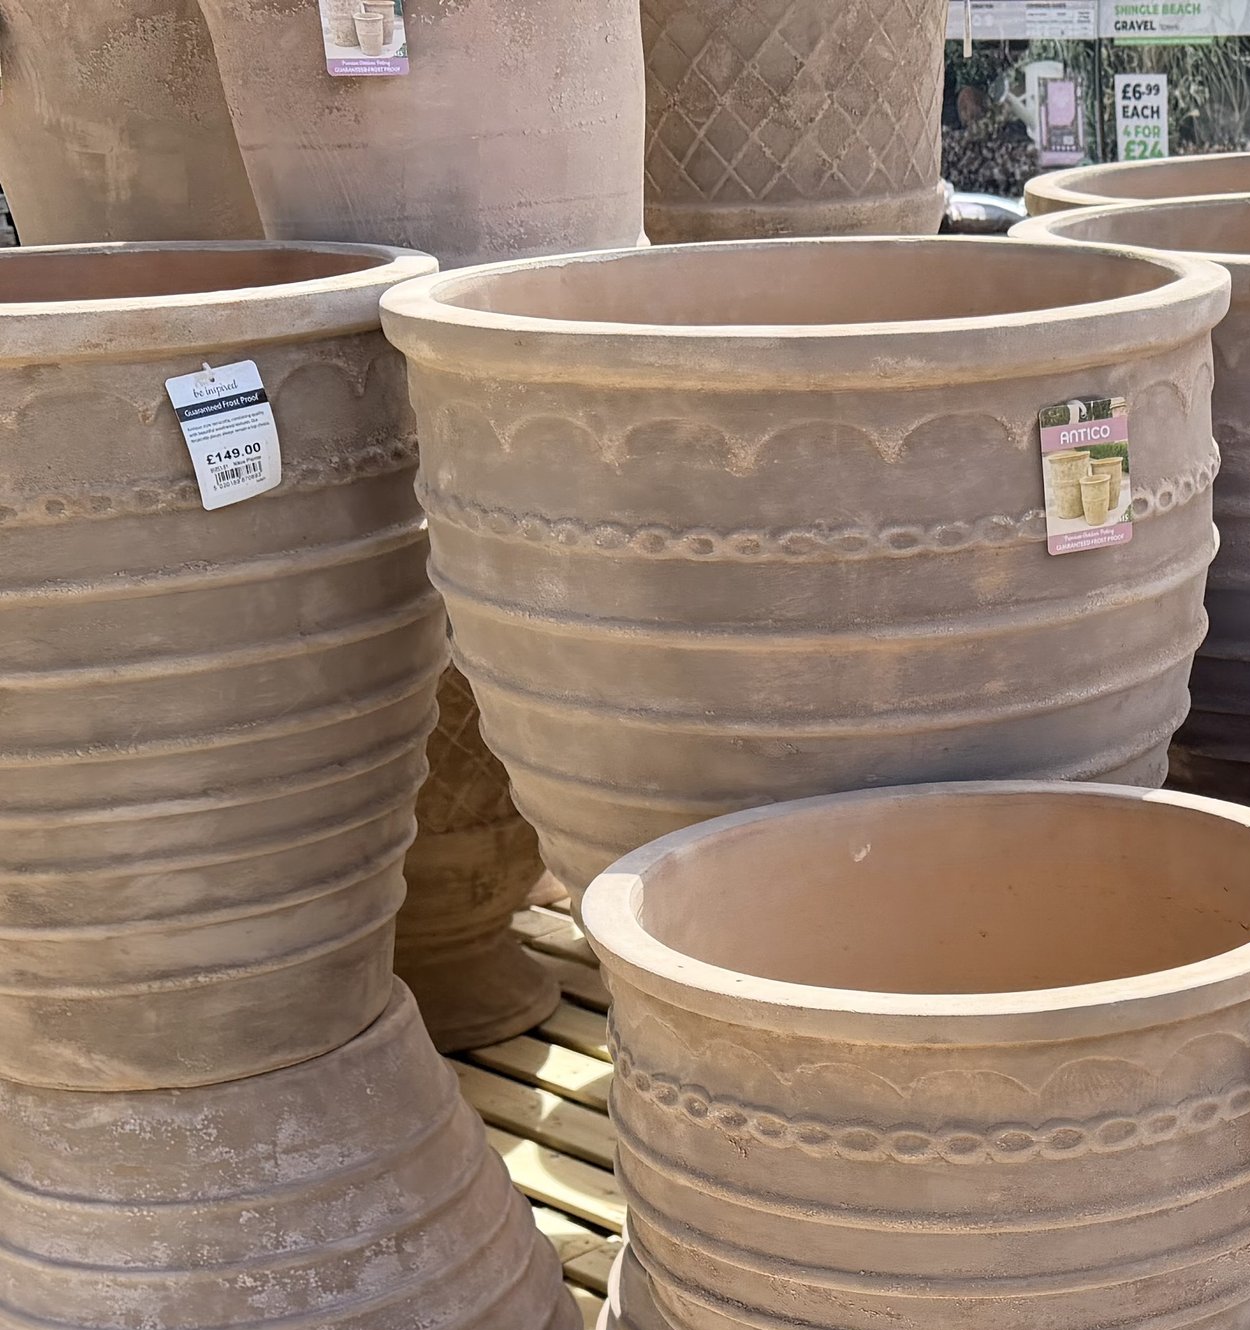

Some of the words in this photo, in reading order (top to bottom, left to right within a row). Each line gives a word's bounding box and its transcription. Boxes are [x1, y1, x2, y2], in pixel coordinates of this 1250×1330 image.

[1114, 4, 1158, 15] SHINGLE
[1162, 3, 1201, 14] BEACH
[1114, 20, 1156, 31] GRAVEL
[1121, 83, 1160, 100] £6.99
[1122, 106, 1160, 119] EACH
[1123, 126, 1131, 137] 4
[1134, 125, 1160, 138] FOR
[1124, 141, 1163, 160] £24
[193, 388, 205, 398] be
[205, 380, 238, 399] inspired
[184, 401, 222, 417] Guaranteed
[222, 397, 240, 408] Frost
[240, 392, 258, 404] Proof
[1060, 425, 1111, 445] ANTICO
[206, 442, 261, 465] £149.00
